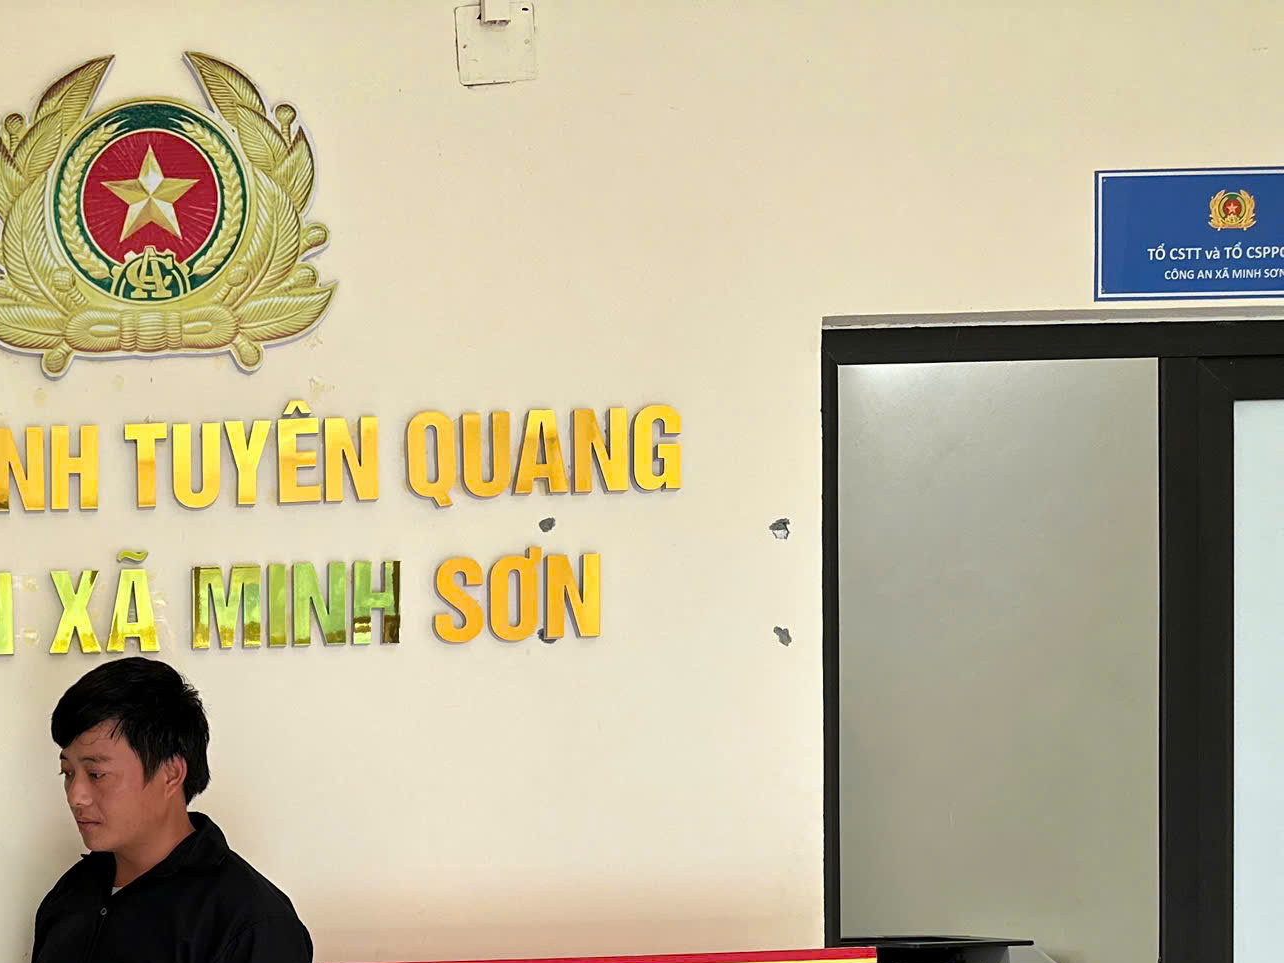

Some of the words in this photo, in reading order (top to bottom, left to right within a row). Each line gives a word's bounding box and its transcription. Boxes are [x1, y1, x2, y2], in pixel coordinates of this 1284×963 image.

[1147, 242, 1166, 261] TỔ
[1169, 247, 1203, 260] CSTT
[1204, 246, 1221, 260] và
[1223, 241, 1243, 259] TỔ
[1164, 267, 1195, 280] CÔNG
[1196, 269, 1213, 280] AN
[1215, 267, 1230, 279] XÃ
[1232, 268, 1262, 279] MINH
[124, 399, 379, 509] TUYÊN
[405, 404, 683, 508] QUANG
[48, 550, 161, 655] XÃ
[192, 559, 402, 649] MINH
[432, 546, 602, 645] SƠN
